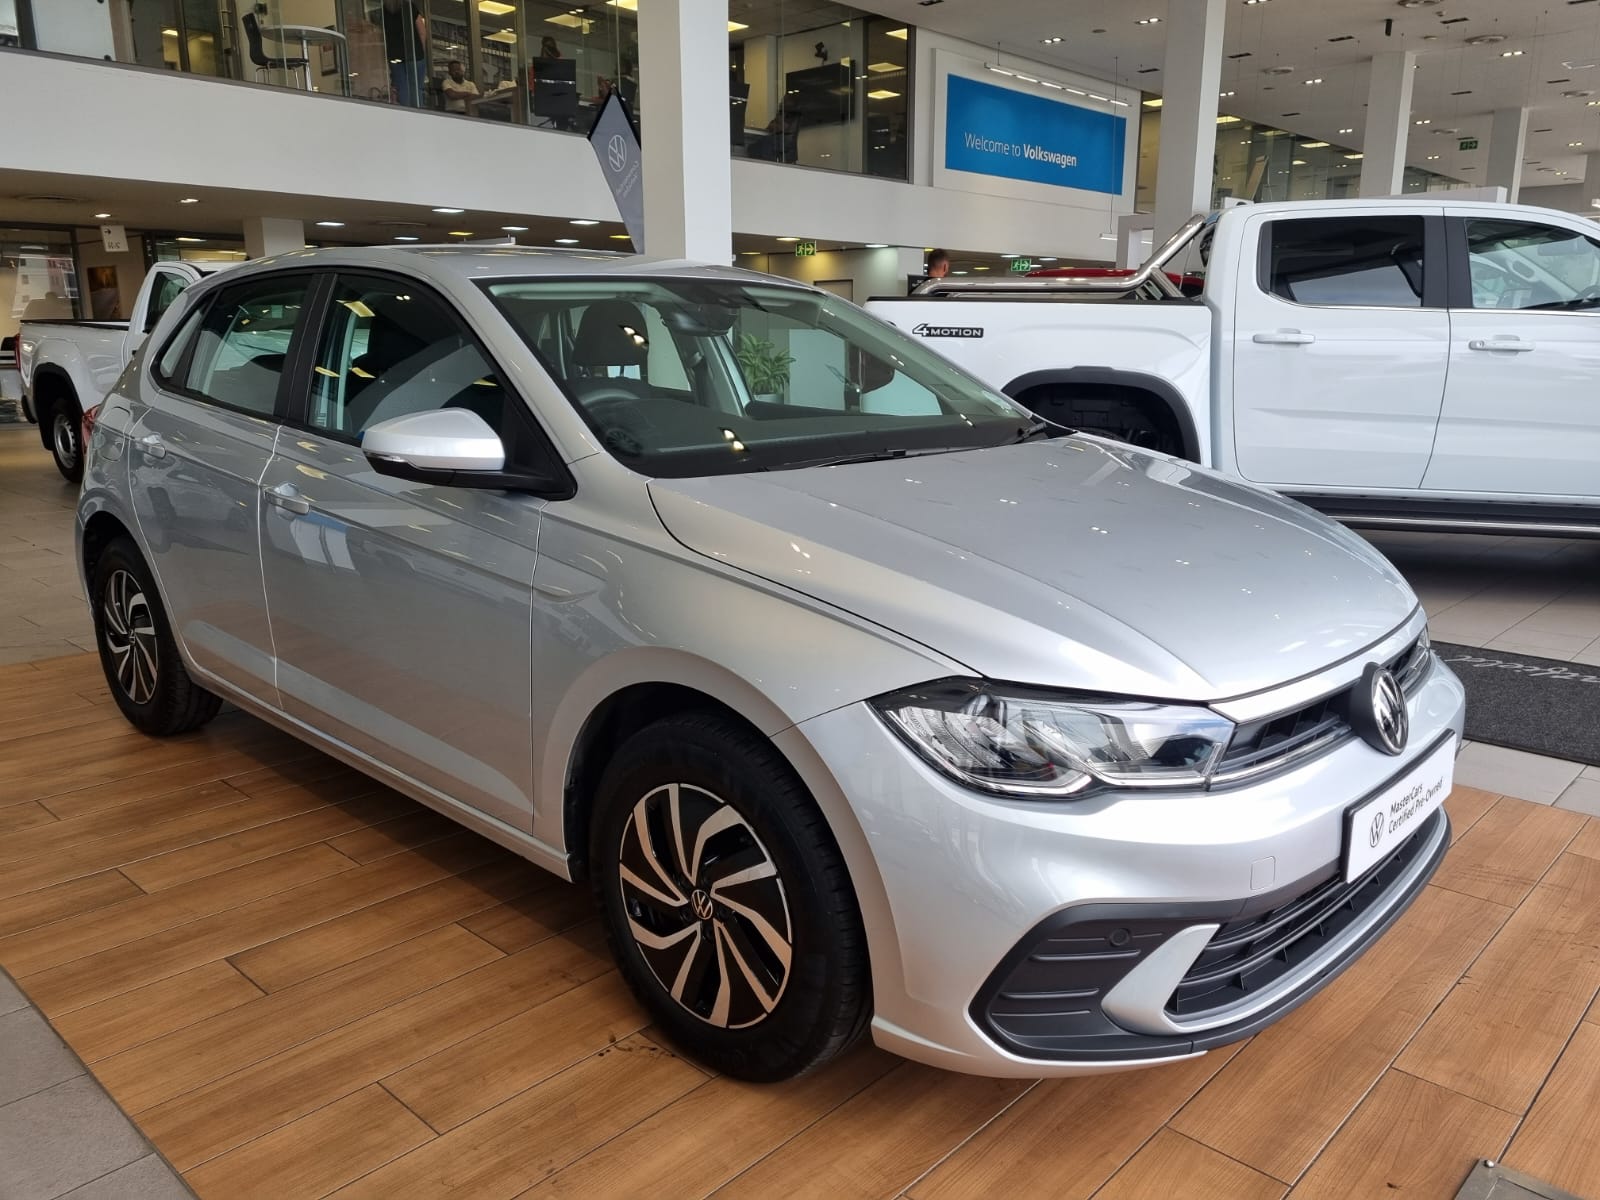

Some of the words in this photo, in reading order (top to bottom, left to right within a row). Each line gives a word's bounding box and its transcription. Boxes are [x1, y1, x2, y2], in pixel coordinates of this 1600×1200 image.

[964, 132, 1009, 155] Welcome
[1012, 144, 1020, 157] to
[1023, 143, 1077, 168] Volkswagen
[912, 323, 983, 338] 4MOTION
[1388, 806, 1415, 834] Certified
[1415, 776, 1443, 815] Pre-Owned
[1390, 784, 1423, 816] MasterCars
